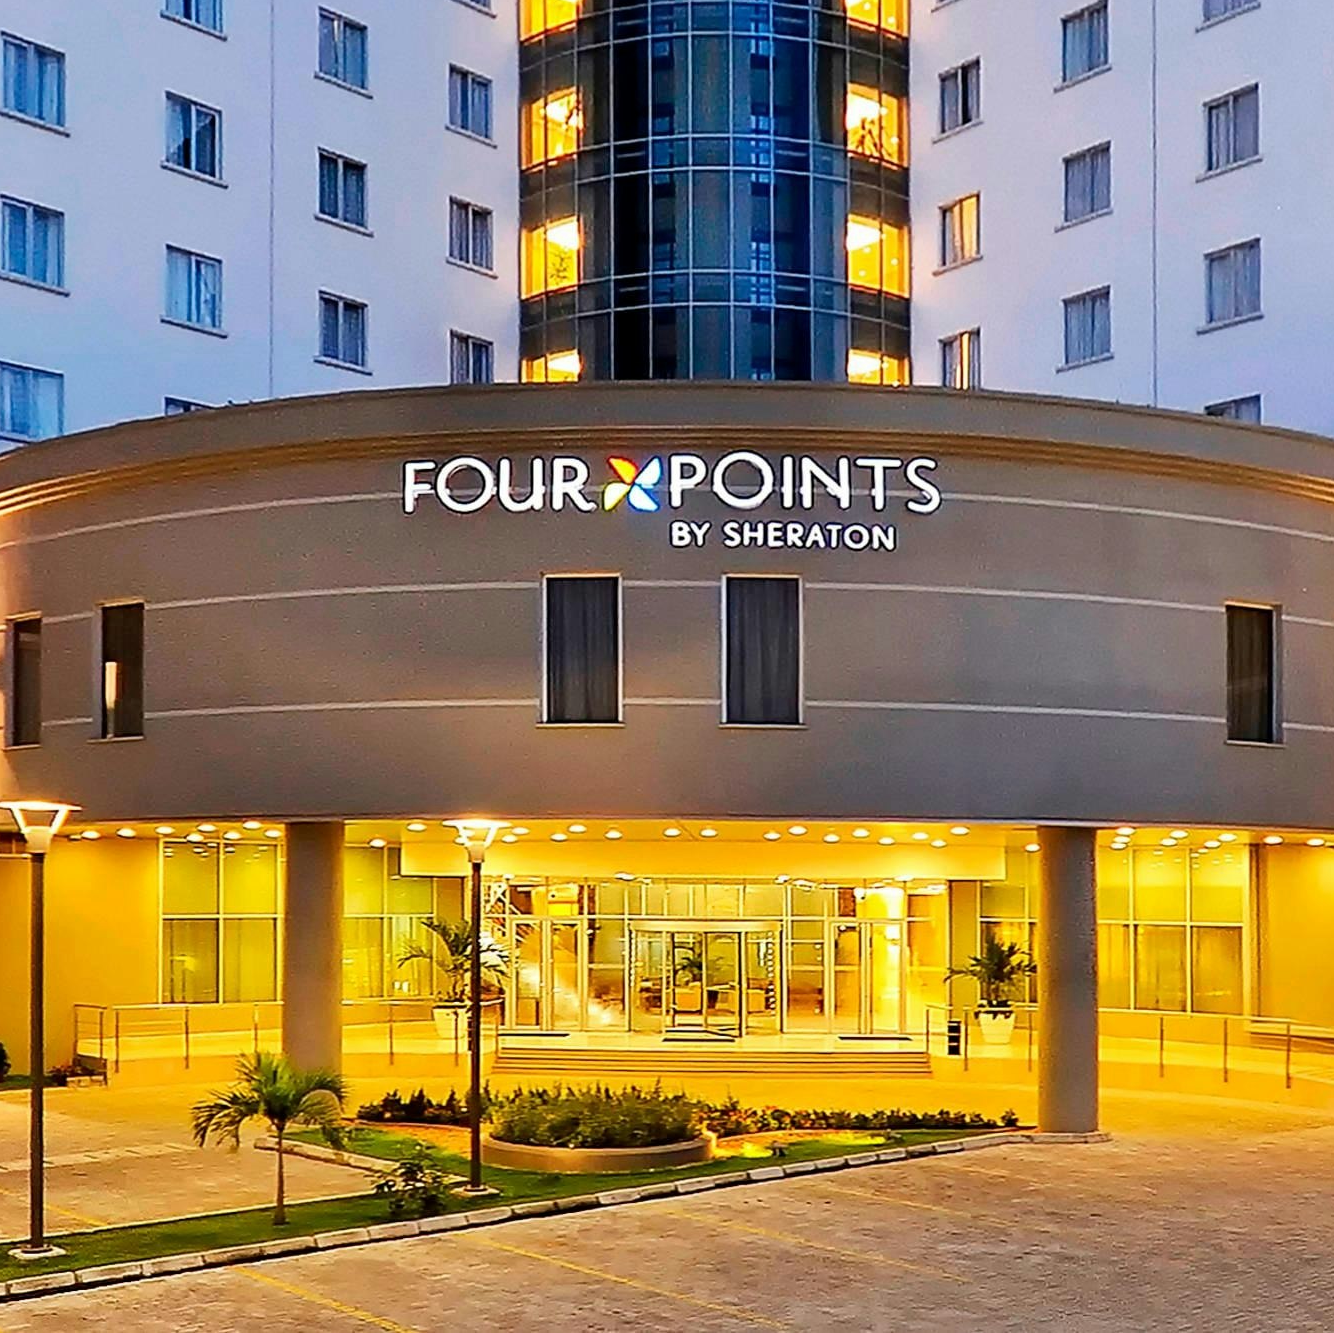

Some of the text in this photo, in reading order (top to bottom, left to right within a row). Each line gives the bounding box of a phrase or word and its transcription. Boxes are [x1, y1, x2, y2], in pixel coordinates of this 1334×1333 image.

[403, 451, 942, 515] FOUR POINTS
[671, 520, 897, 551] BY SHERATON
